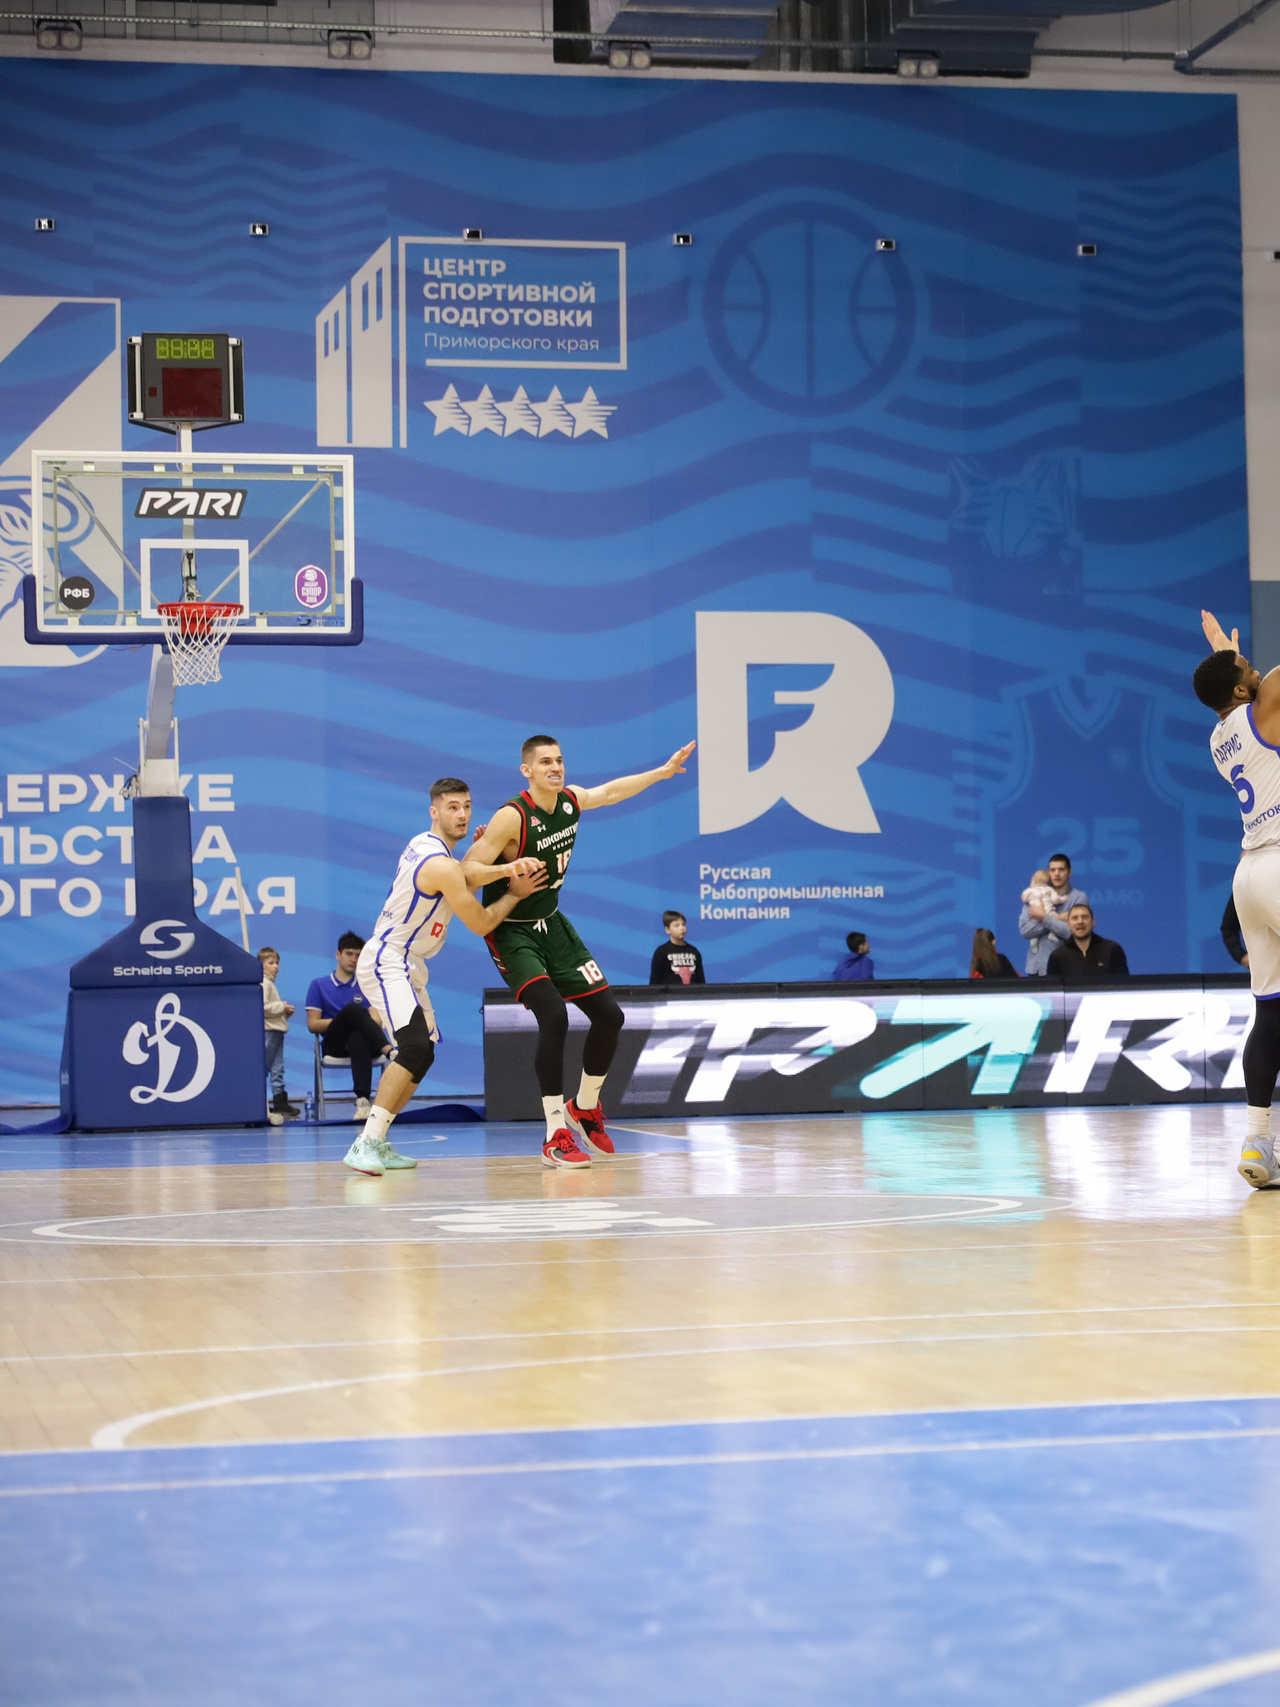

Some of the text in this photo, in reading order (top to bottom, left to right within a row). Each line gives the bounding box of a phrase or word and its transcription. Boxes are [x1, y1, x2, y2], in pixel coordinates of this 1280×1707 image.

[423, 257, 507, 278] ЦЕНТР
[423, 281, 596, 303] СПОРТИВНОЙ
[424, 306, 593, 328] ПОДГОТОВКИ
[424, 332, 599, 353] Приморского края
[138, 491, 243, 517] PARI
[64, 588, 90, 599] РФБ
[1230, 764, 1255, 814] 6
[699, 864, 772, 884] Русская
[700, 883, 885, 903] Рыбопромышленная
[700, 904, 791, 920] Компания
[113, 964, 223, 977] Schelde Sports
[576, 959, 605, 985] 18
